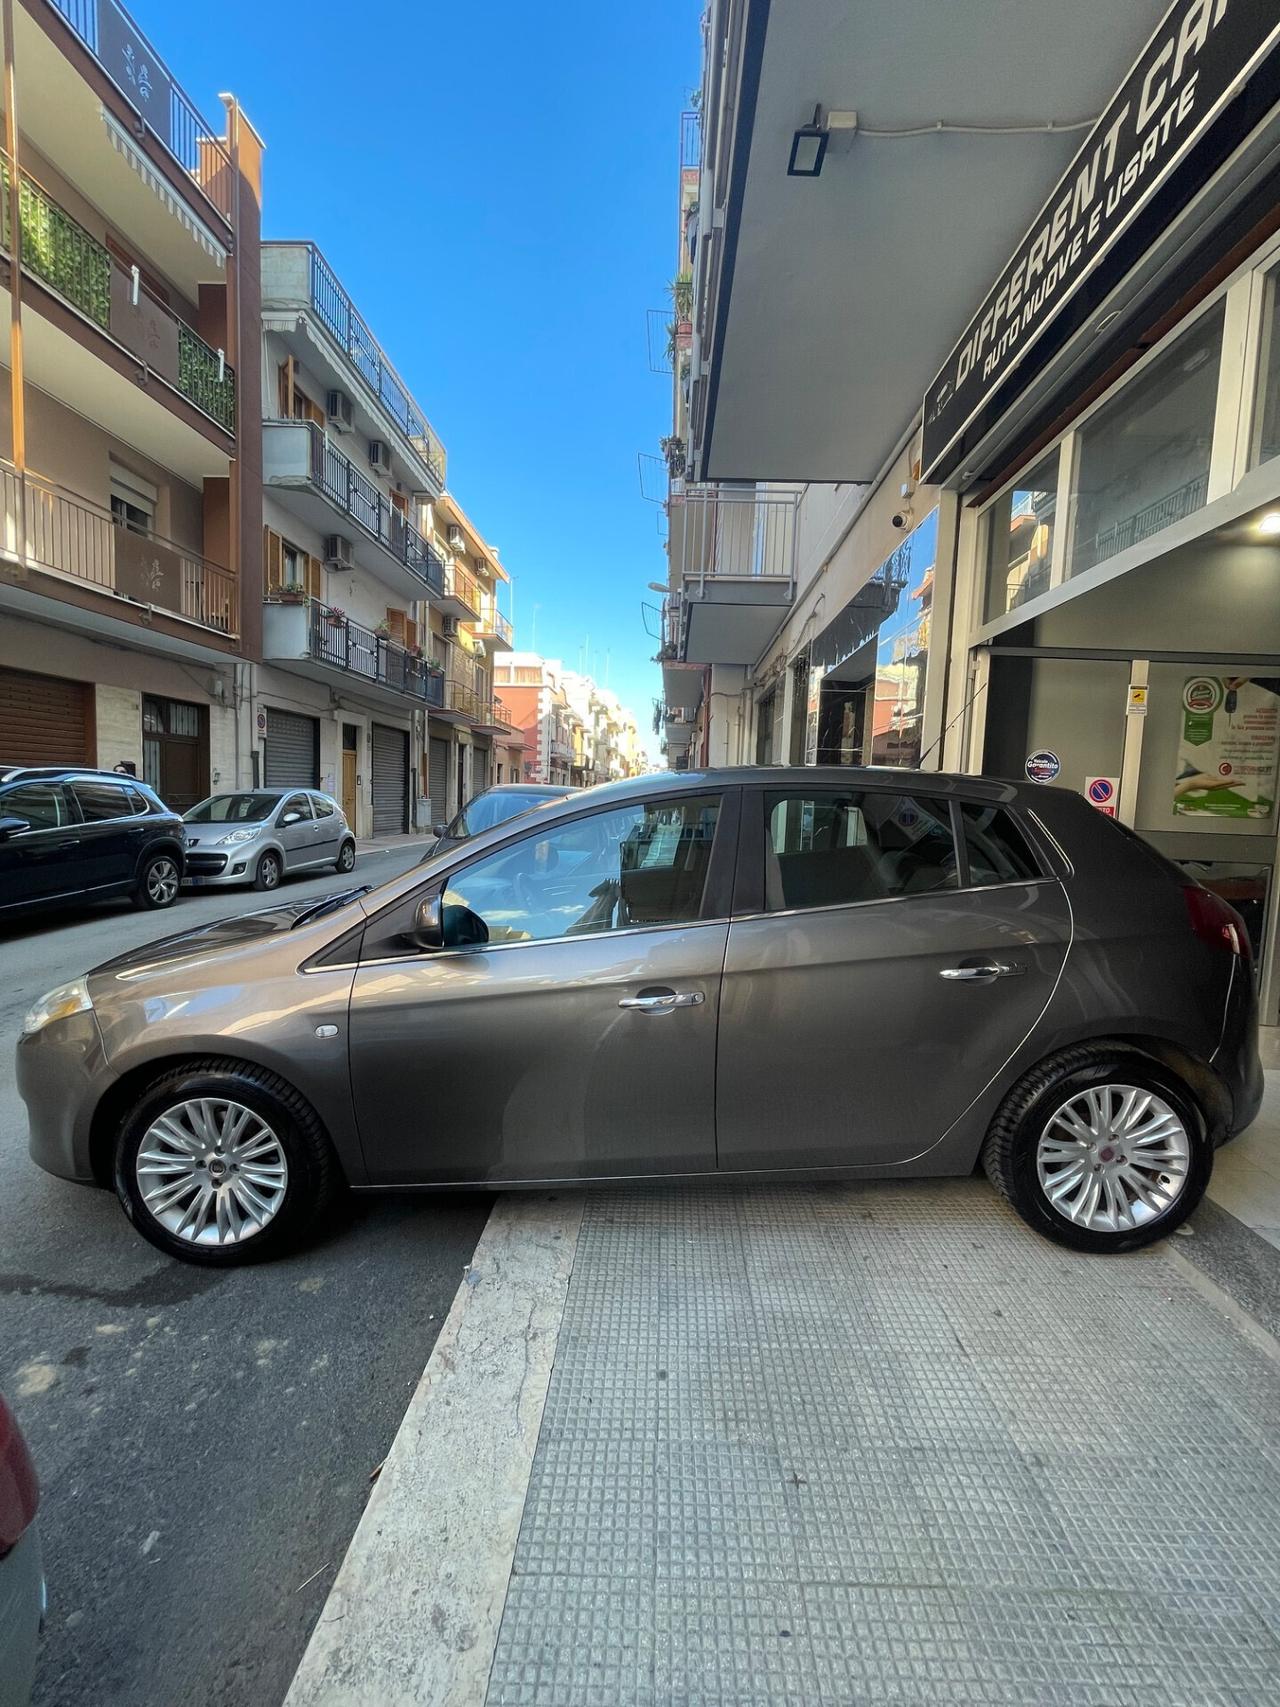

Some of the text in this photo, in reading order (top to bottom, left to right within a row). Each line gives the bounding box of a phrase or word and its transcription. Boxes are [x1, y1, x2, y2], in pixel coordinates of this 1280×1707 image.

[955, 101, 1130, 391] DIFFERENT
[982, 68, 1199, 382] AUTO NUOVE E USATE
